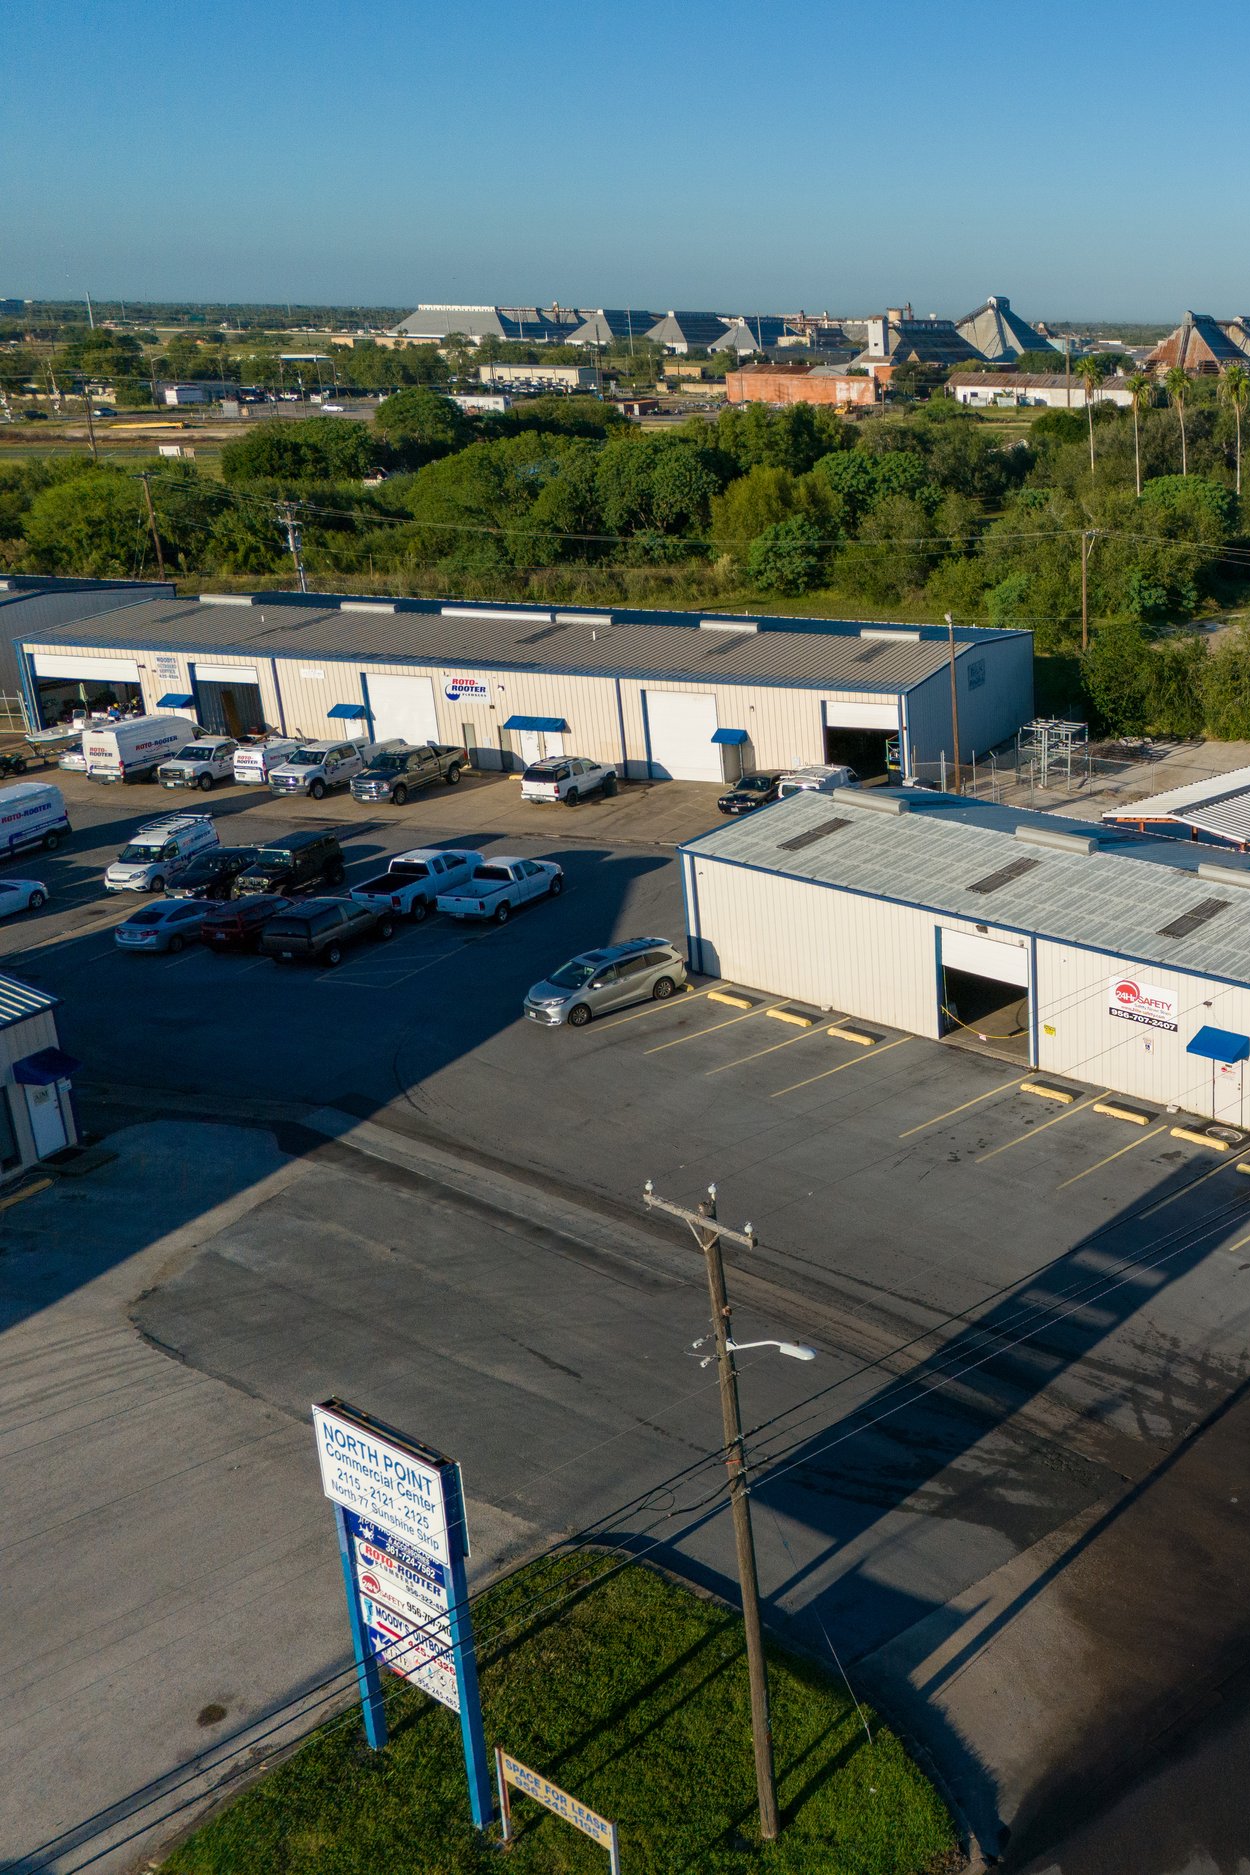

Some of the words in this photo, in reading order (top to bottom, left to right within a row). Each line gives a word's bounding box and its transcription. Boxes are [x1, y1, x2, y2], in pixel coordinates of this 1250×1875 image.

[451, 685, 486, 693] ROOTER
[452, 678, 479, 686] ROTO-
[135, 735, 178, 751] ROTO-ROOTER
[1111, 1009, 1175, 1030] 956-707-2407
[1138, 996, 1172, 1011] SAFETY
[323, 1422, 379, 1466] NORTH
[383, 1454, 432, 1496] POINT
[325, 1442, 393, 1490] Commercial
[397, 1482, 436, 1514] Center
[331, 1479, 356, 1502] North
[358, 1495, 368, 1509] 77
[371, 1502, 415, 1536] Sunshine
[417, 1528, 440, 1551] Strip
[337, 1468, 361, 1490] 2115
[370, 1486, 394, 1509] 2121
[404, 1505, 429, 1530] 2125
[365, 1545, 441, 1597] ROTO-ROOTER
[375, 1560, 414, 1588] PLUMBERS
[385, 1543, 436, 1579] 361-724-7562
[375, 1605, 410, 1634] MOODY'S
[505, 1759, 541, 1789] SPACE
[545, 1784, 567, 1807] FOR
[571, 1802, 608, 1836] LEASE
